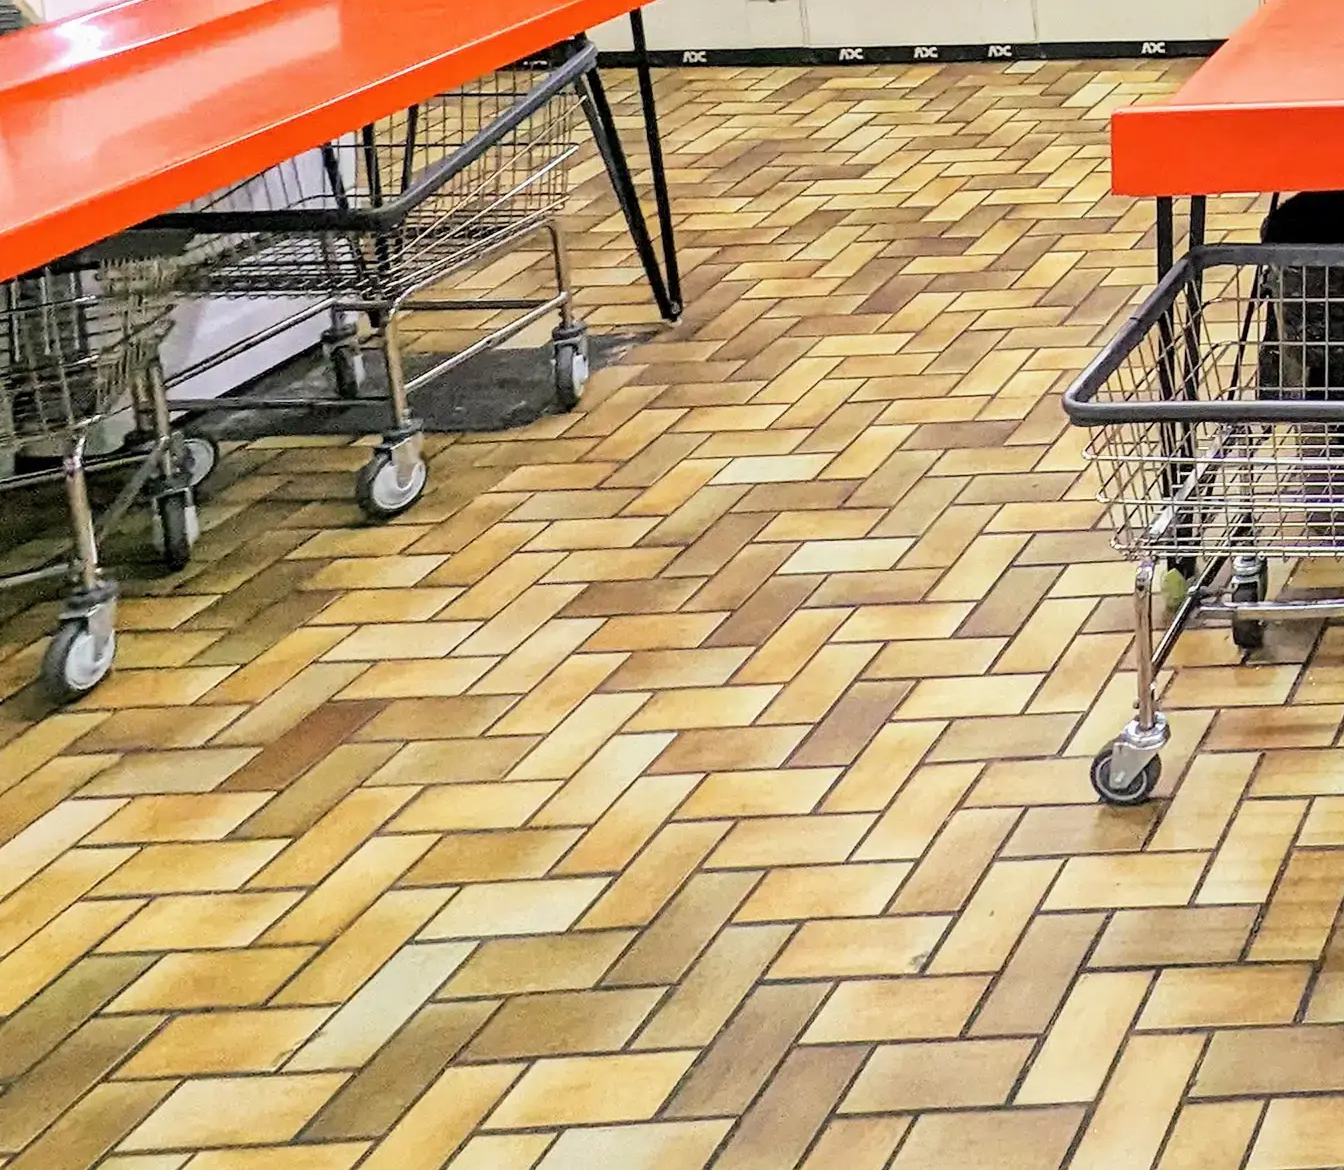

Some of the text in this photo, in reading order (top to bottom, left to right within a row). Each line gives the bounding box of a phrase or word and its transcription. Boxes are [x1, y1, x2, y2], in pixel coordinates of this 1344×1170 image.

[839, 48, 864, 61] ADC
[914, 46, 939, 59] ADC
[988, 45, 1013, 57] ADC
[1141, 42, 1166, 54] ADC
[683, 50, 708, 63] ADC
